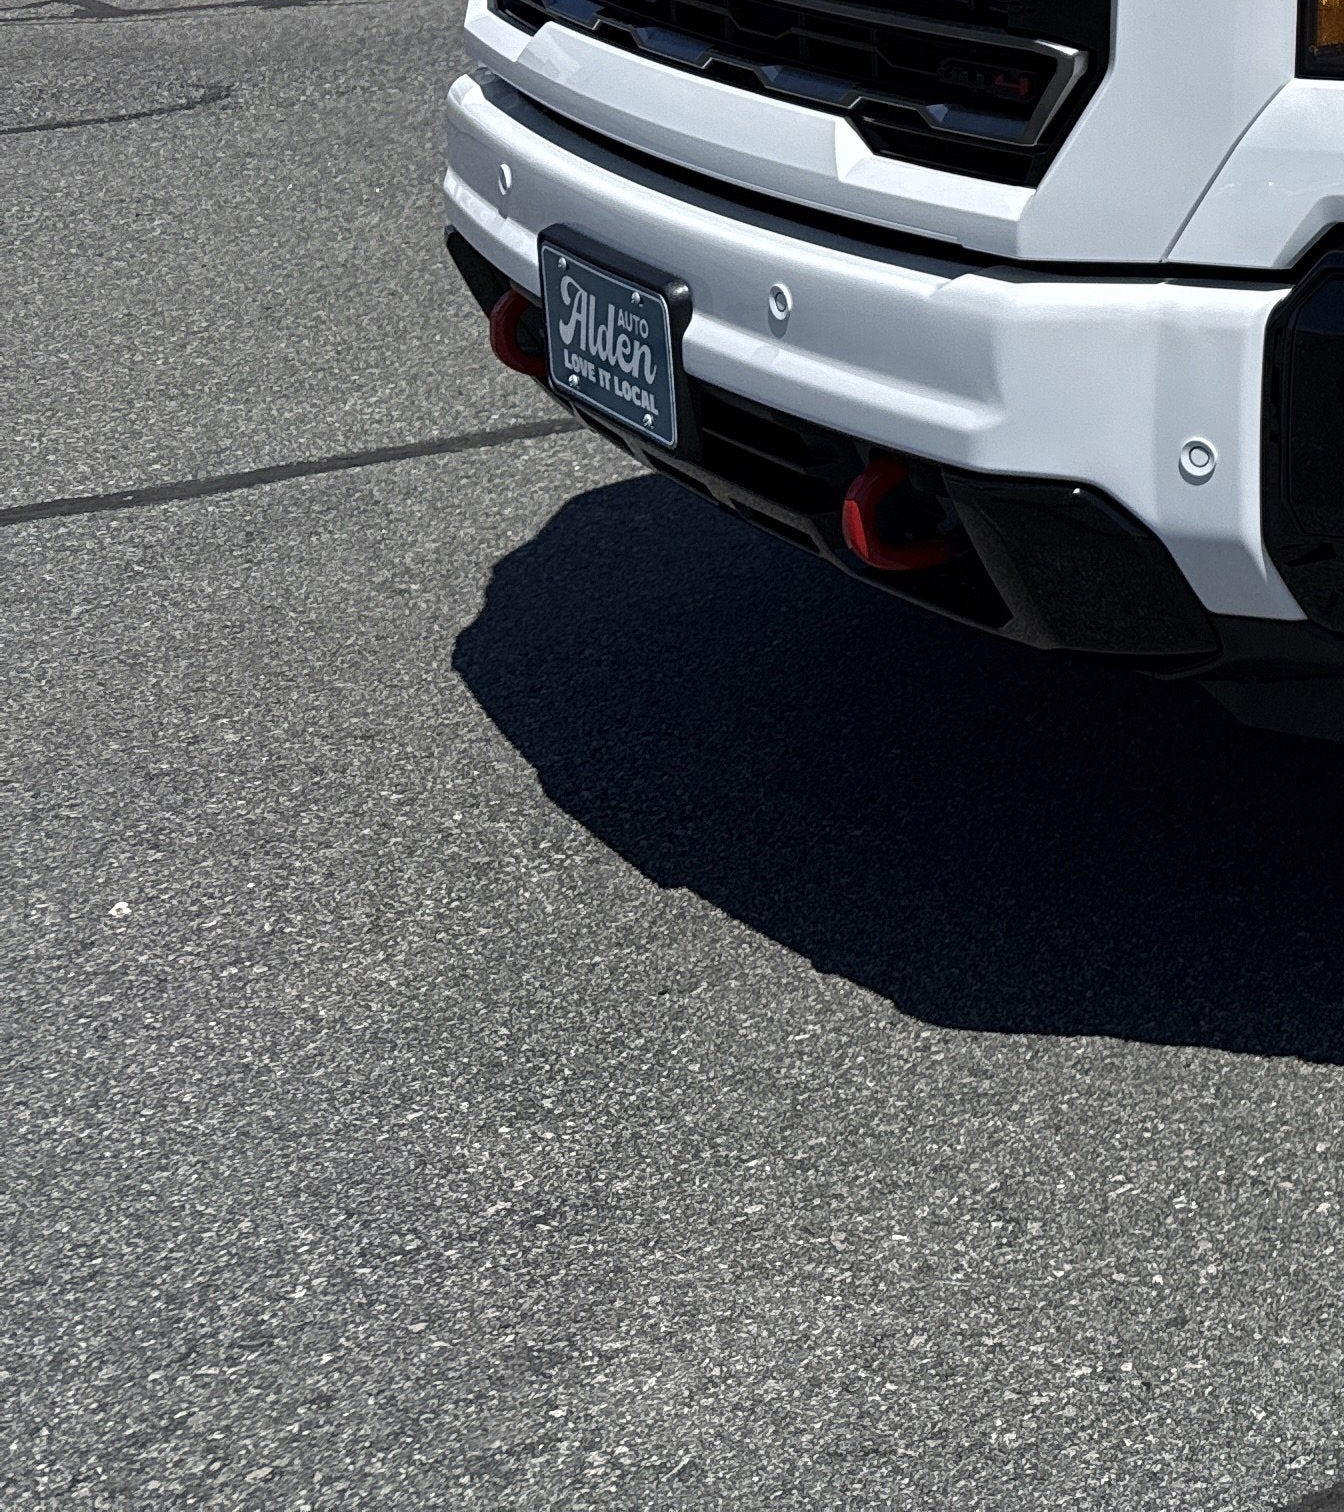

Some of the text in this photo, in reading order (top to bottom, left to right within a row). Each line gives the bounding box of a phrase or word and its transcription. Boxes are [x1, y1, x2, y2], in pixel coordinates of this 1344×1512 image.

[559, 275, 657, 385] Alden
[617, 308, 649, 339] AUTO
[563, 348, 659, 416] LOVE IT LOCAL
